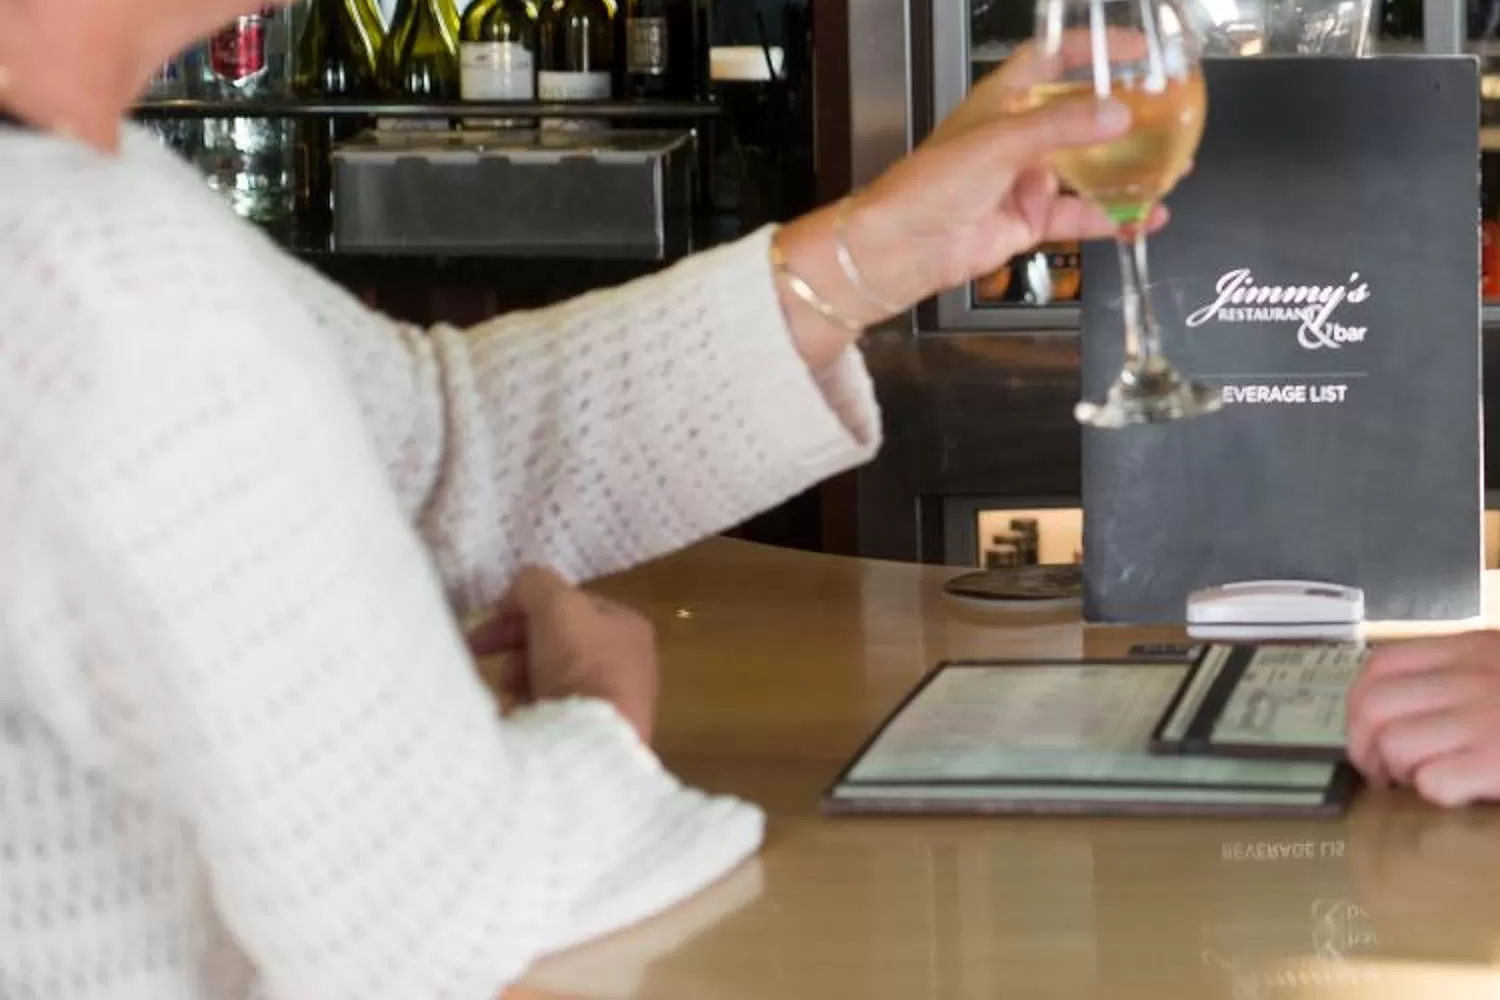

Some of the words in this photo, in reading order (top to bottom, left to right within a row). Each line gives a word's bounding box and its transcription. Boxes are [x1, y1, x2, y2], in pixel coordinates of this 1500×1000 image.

[1185, 267, 1371, 328] Jimmy's
[1333, 324, 1368, 342] bar
[1221, 384, 1307, 403] EVERAGE
[1309, 384, 1348, 403] LIST
